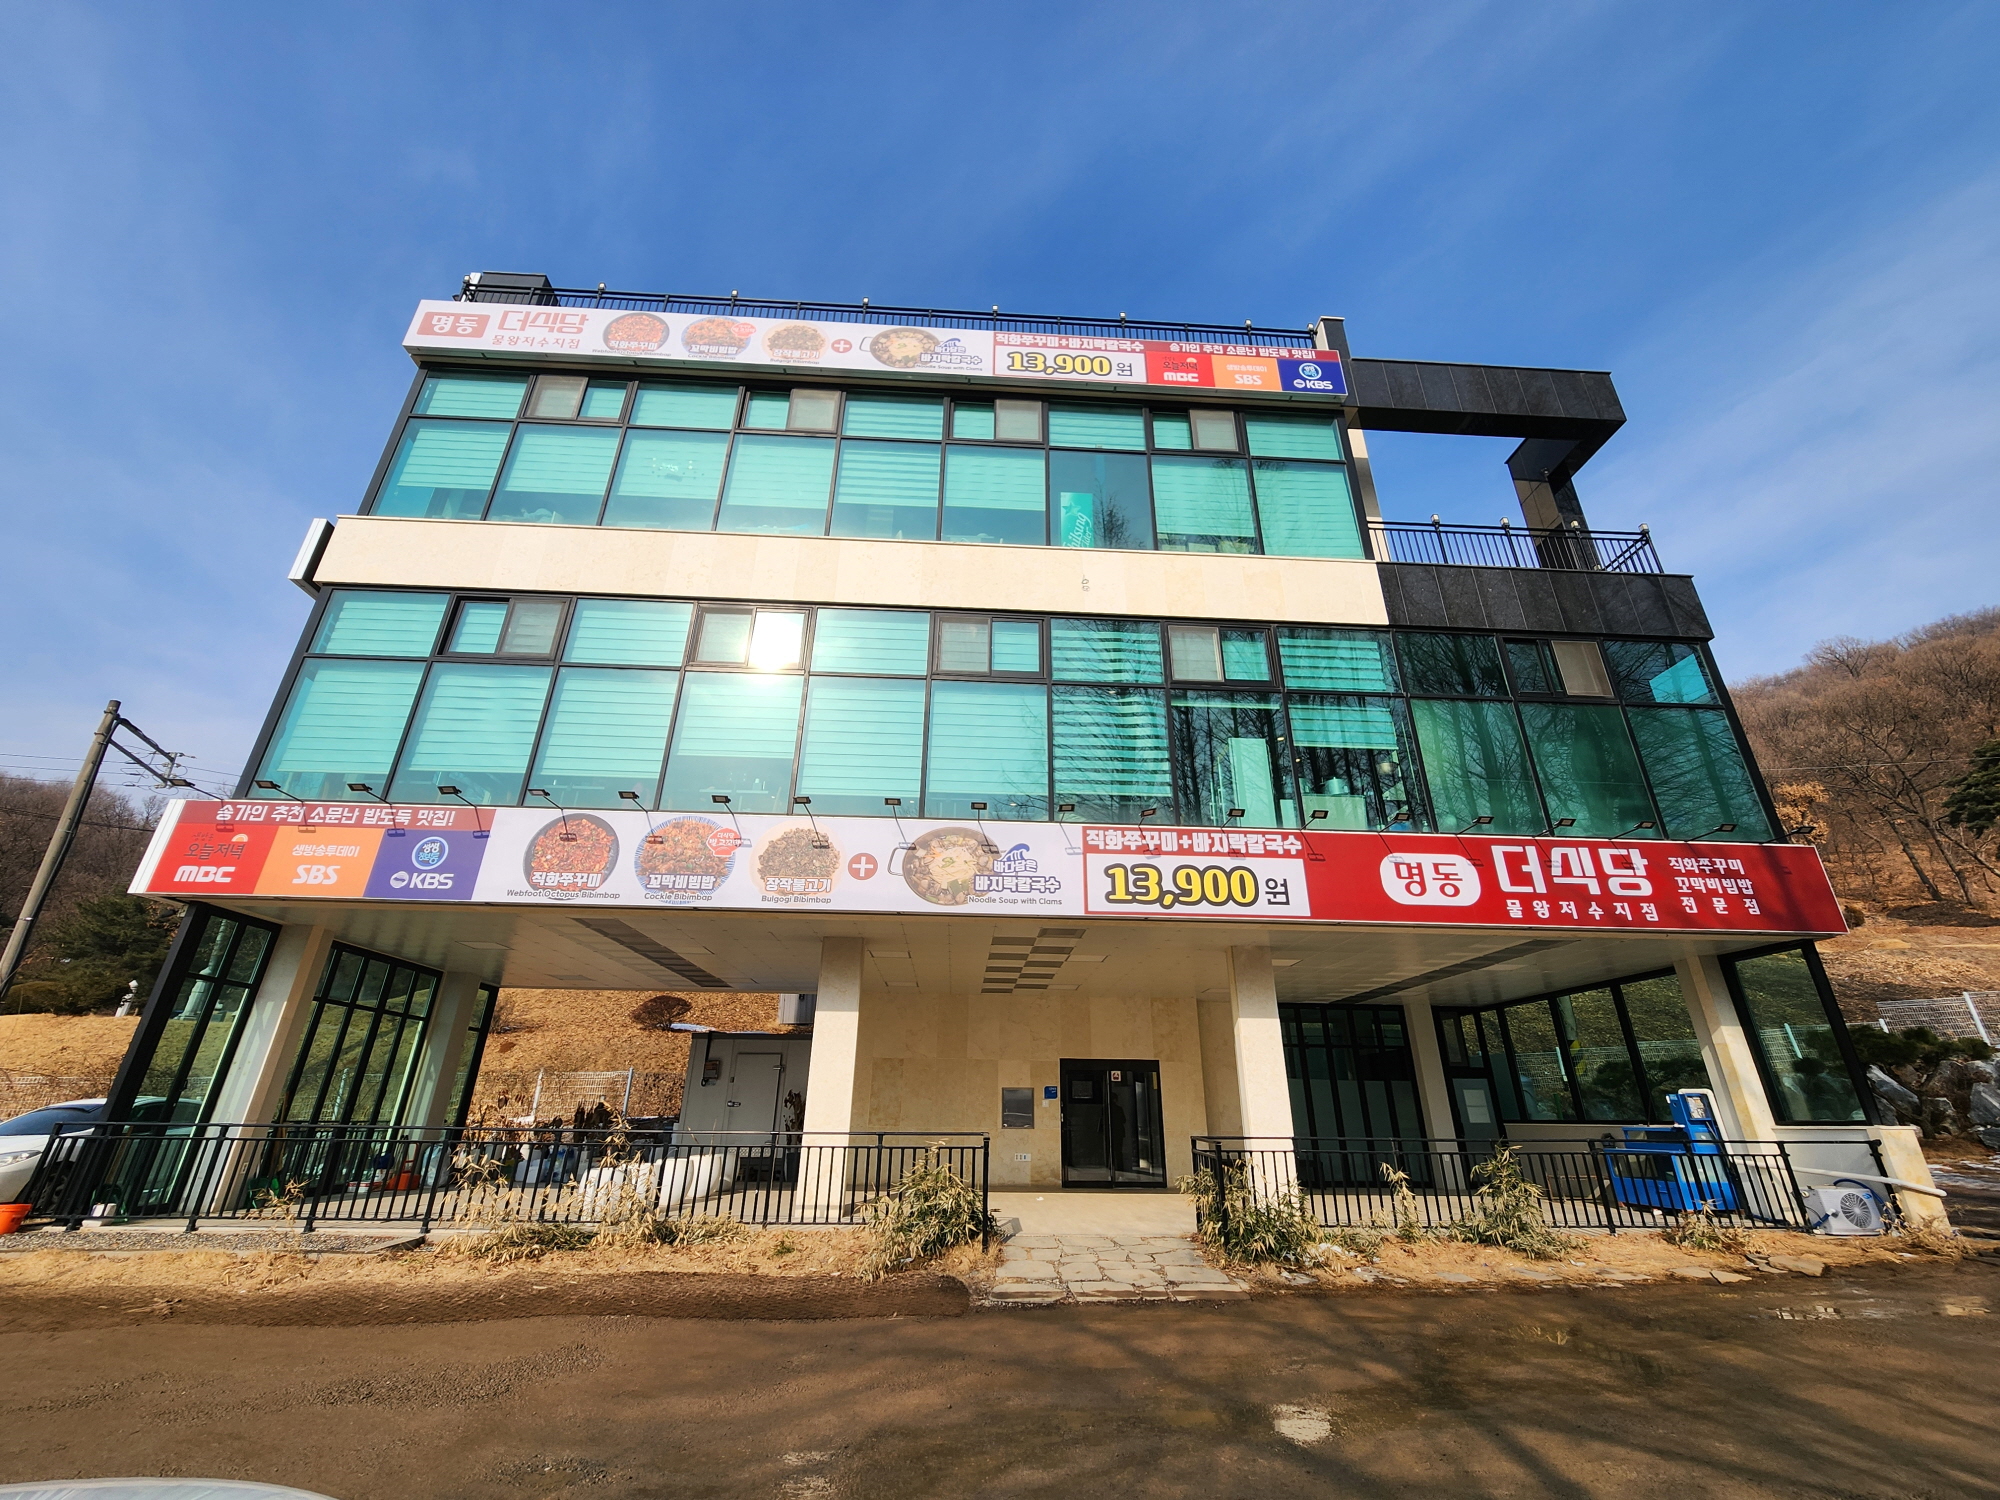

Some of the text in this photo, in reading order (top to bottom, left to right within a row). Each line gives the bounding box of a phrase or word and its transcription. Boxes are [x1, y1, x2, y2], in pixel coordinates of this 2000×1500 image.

[432, 310, 589, 334] 명동 더식당
[492, 335, 581, 349] 물왕저수지점
[1170, 343, 1316, 359] 송가인 추천 소문난 밥도둑 맛집!
[1007, 351, 1133, 377] 13,900 원
[1163, 361, 1198, 371] 오늘저녁
[1163, 372, 1199, 382] MBC
[1234, 374, 1262, 385] SBS
[1306, 380, 1333, 389] KBS
[216, 804, 456, 827] 송가인 추천 소문난 밥도둑 맛집!
[1086, 830, 1302, 855] 직화쭈꾸미+바지락칼국수
[184, 843, 245, 860] 오늘저녁
[291, 844, 360, 858] 생방송투데이
[173, 865, 236, 883] MBC
[993, 859, 1037, 873] 바다담은
[1394, 845, 1653, 898] 명동 더식당
[1668, 857, 1745, 875] 직화쭈꾸미
[292, 864, 341, 885] SBS
[409, 873, 455, 889] KBS
[532, 871, 602, 888] 직화쭈꾸미
[646, 874, 716, 890] 꼬막비빔밥
[766, 877, 832, 892] 장작불고기
[975, 875, 1061, 893] 바지락칼국수
[1104, 863, 1290, 909] 13,900 원
[1674, 876, 1754, 895] 꼬막비빔밥
[507, 889, 620, 900] Webfoot Octopus Bibimbap
[674, 893, 713, 901] Bibimbap
[761, 895, 832, 904] Bulgogi Bibimbap
[968, 896, 996, 904] Noodle
[998, 897, 1019, 905] Soup
[1039, 898, 1063, 906] Clams
[1506, 899, 1659, 921] 물왕저수지점
[1680, 896, 1761, 915] 전문점
